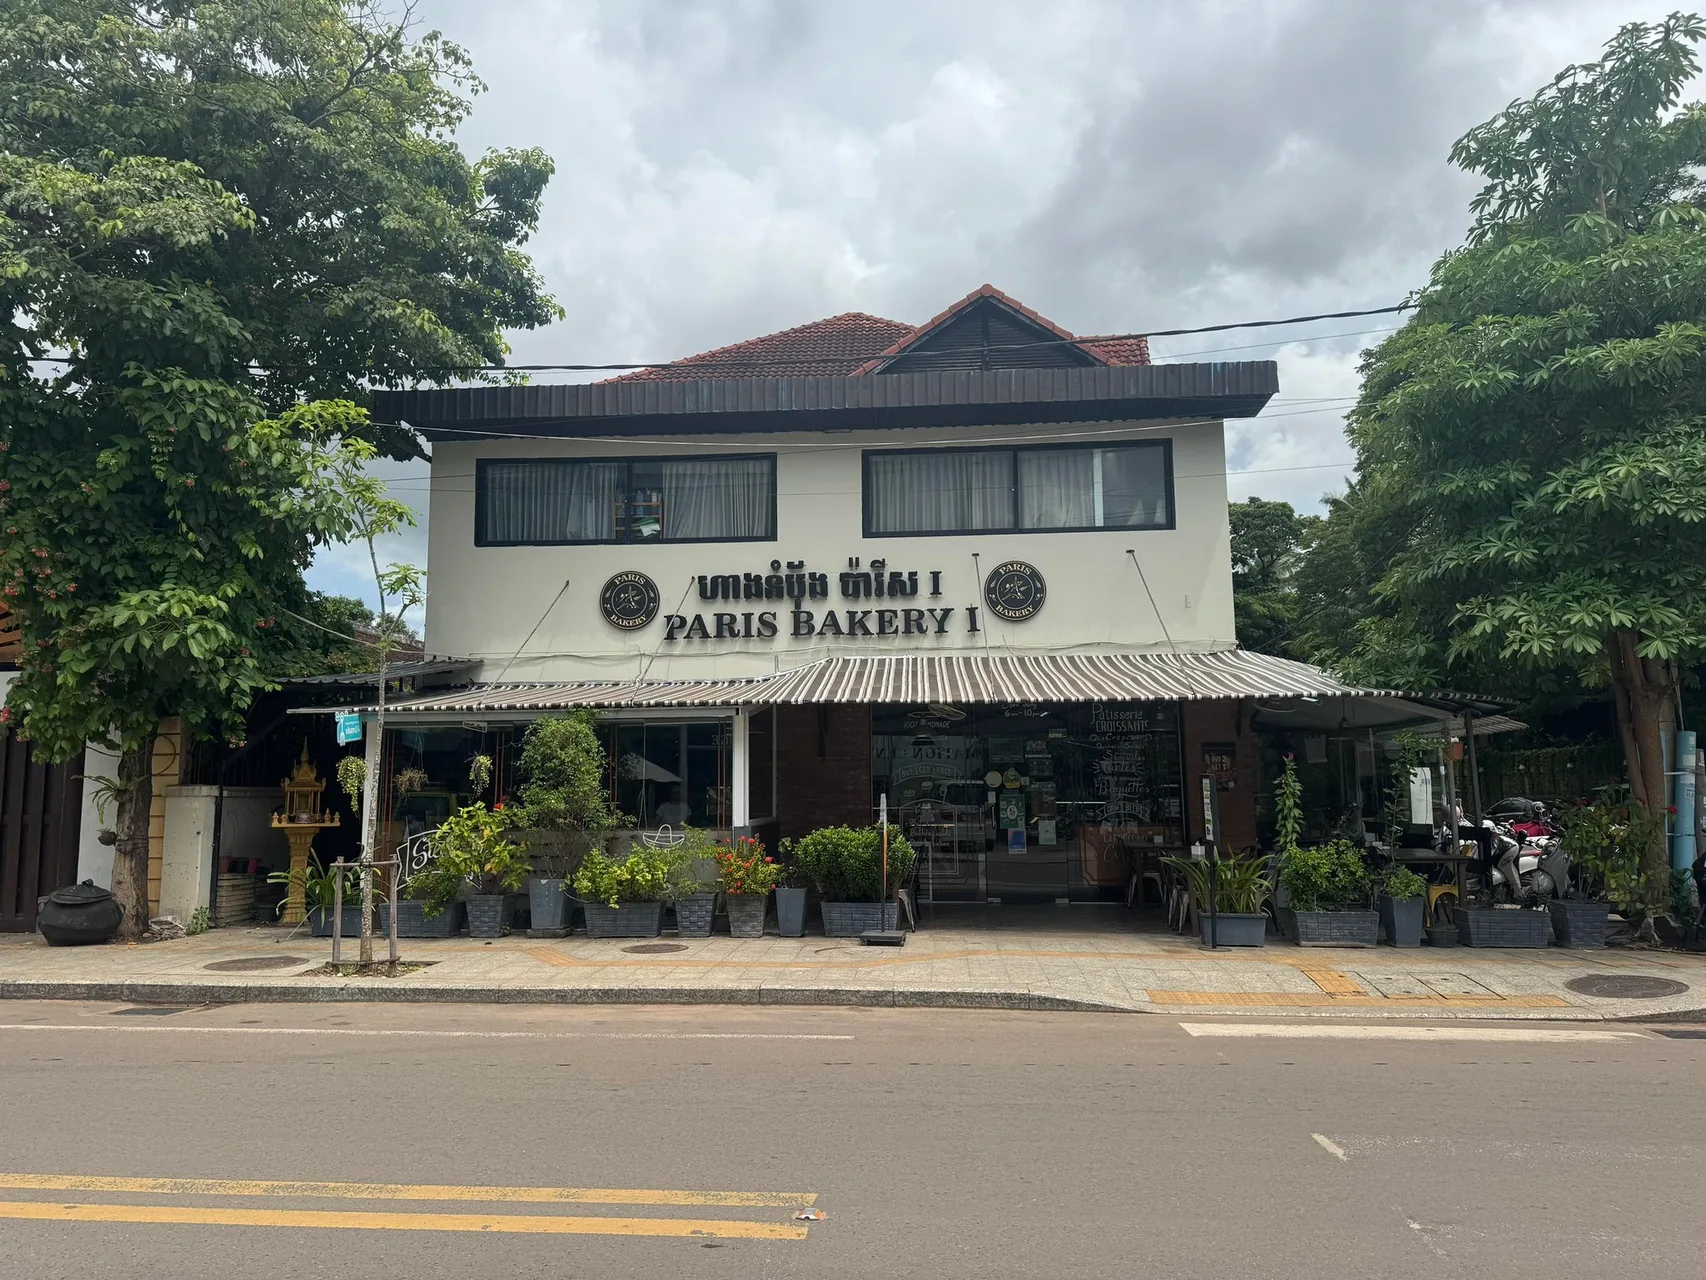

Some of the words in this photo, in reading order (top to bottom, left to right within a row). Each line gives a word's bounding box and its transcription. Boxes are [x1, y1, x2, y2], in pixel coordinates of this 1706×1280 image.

[998, 563, 1032, 575] PARIS
[613, 573, 646, 585] PARIS
[995, 604, 1034, 617] BAKERY
[610, 613, 647, 626] BAKERY
[663, 611, 779, 641] PARIS
[790, 606, 955, 637] BAKERY
[965, 605, 981, 634] I
